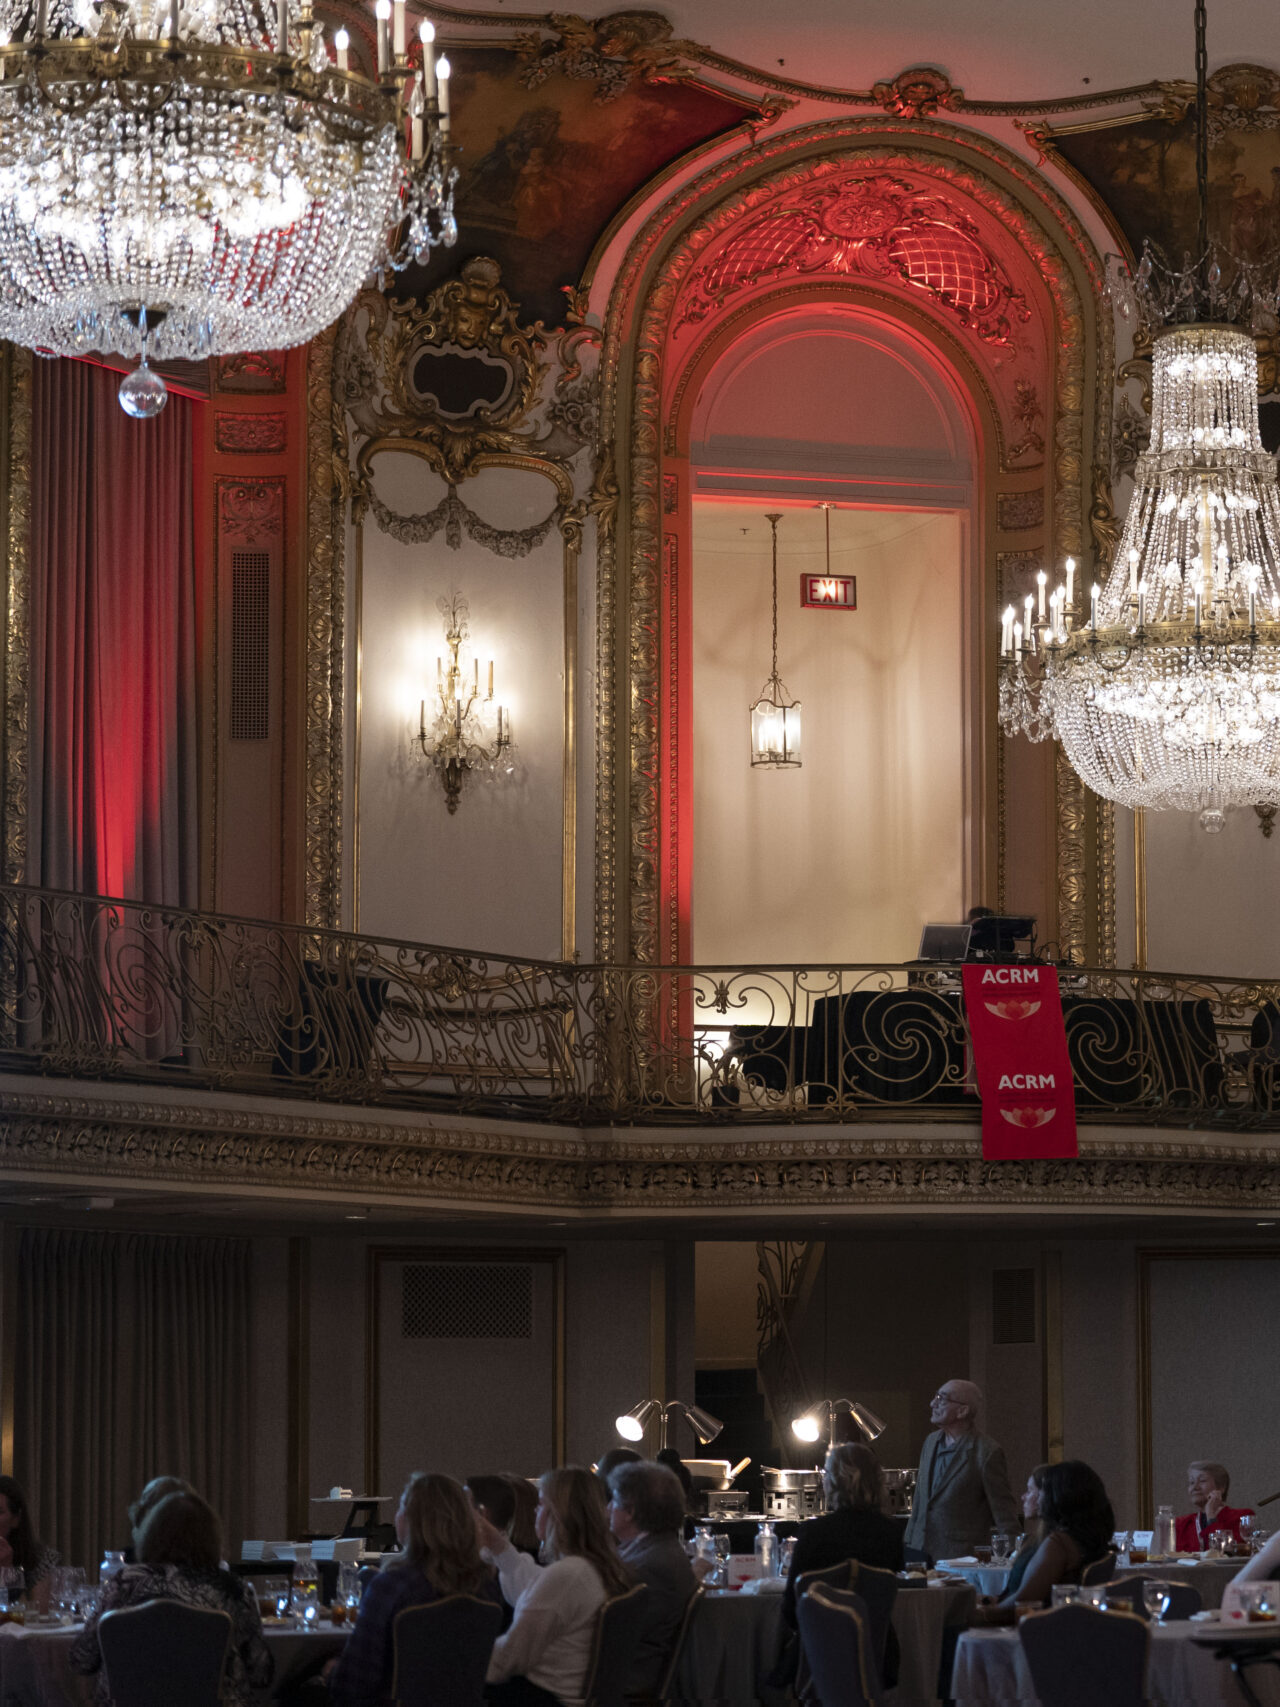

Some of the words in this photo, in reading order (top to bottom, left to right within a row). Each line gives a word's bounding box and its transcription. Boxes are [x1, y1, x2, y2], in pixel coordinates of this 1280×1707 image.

[809, 579, 851, 604] EXIT
[981, 968, 1040, 984] ACRM
[998, 1074, 1056, 1090] ACRM
